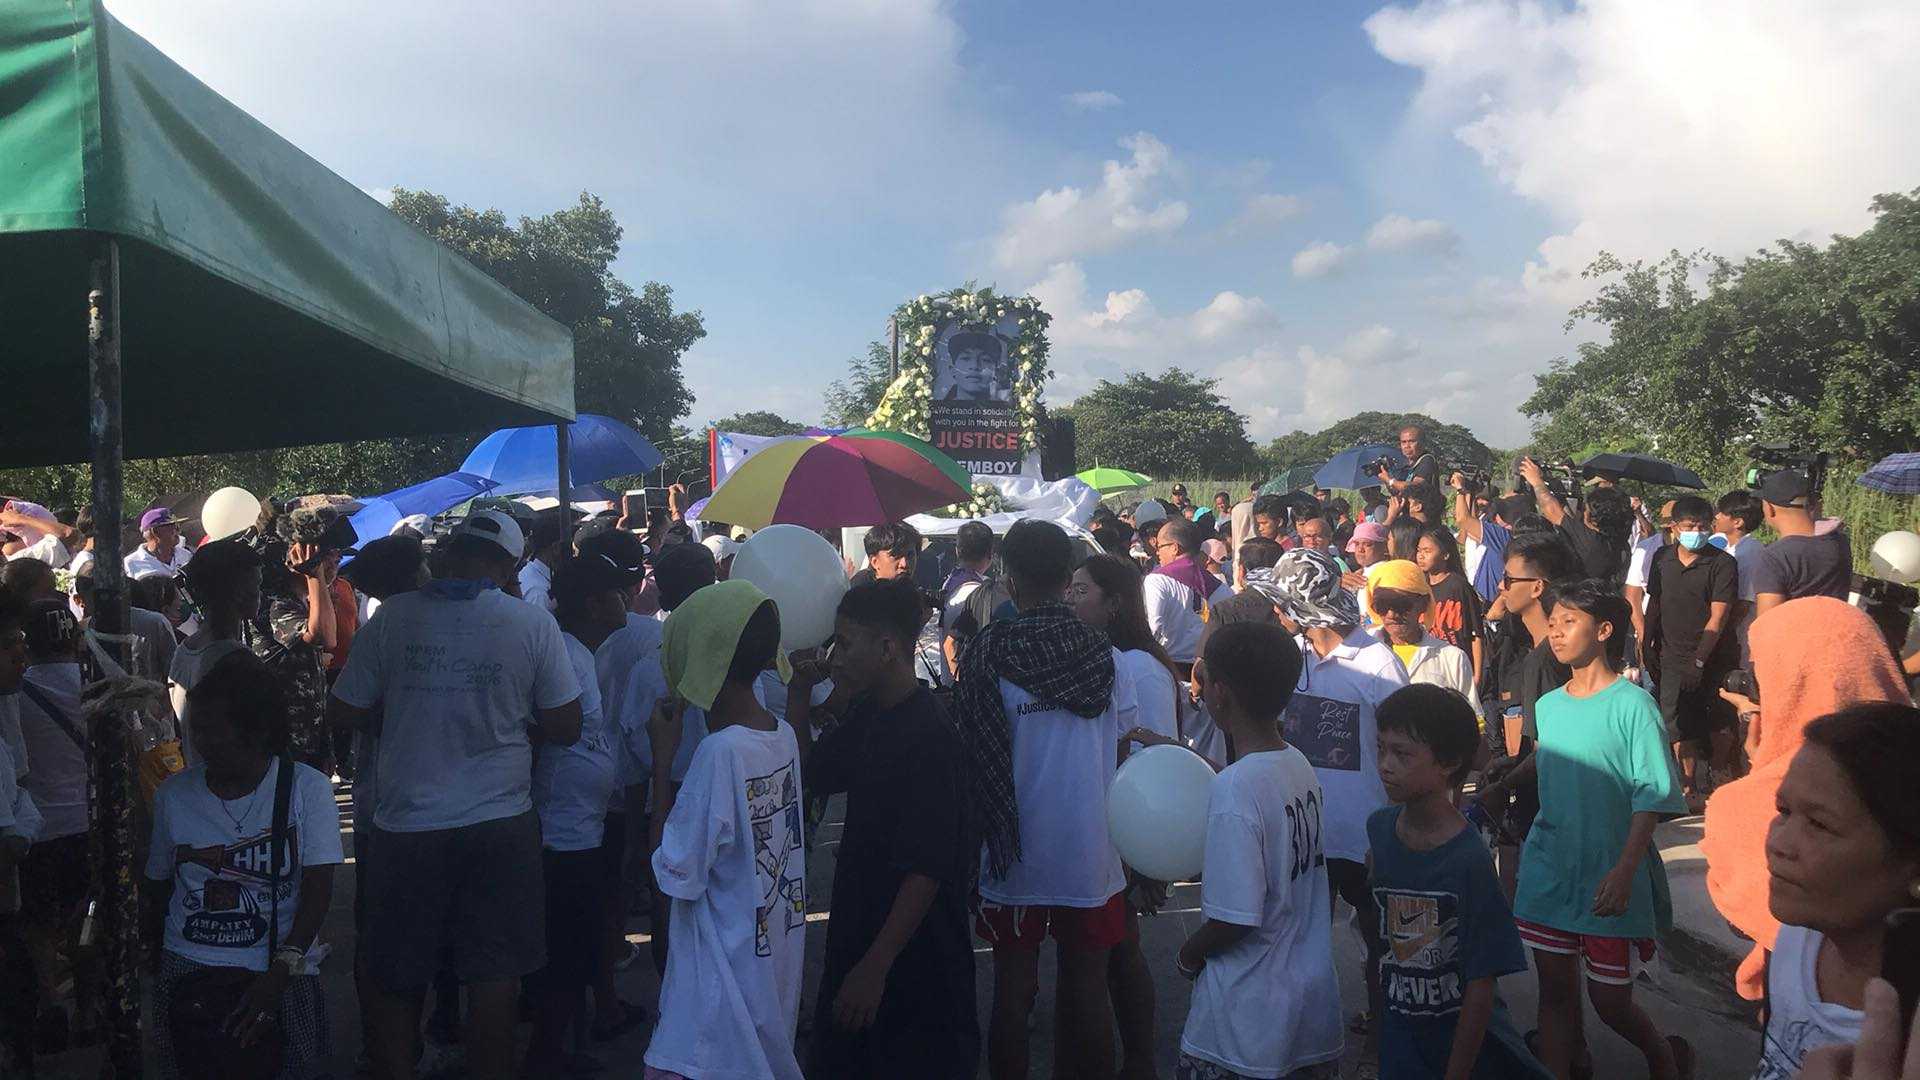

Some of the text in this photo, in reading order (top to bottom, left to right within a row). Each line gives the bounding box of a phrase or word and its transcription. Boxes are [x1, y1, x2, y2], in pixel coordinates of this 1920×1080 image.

[952, 407, 972, 415] stand
[953, 420, 966, 428] you
[976, 419, 989, 427] the
[990, 419, 1007, 429] fight
[1008, 419, 1019, 427] for
[936, 431, 1018, 450] JUSTICE
[957, 460, 1017, 474] EMBOY
[1319, 700, 1358, 724] Rest
[1388, 971, 1461, 1006] NEVER
